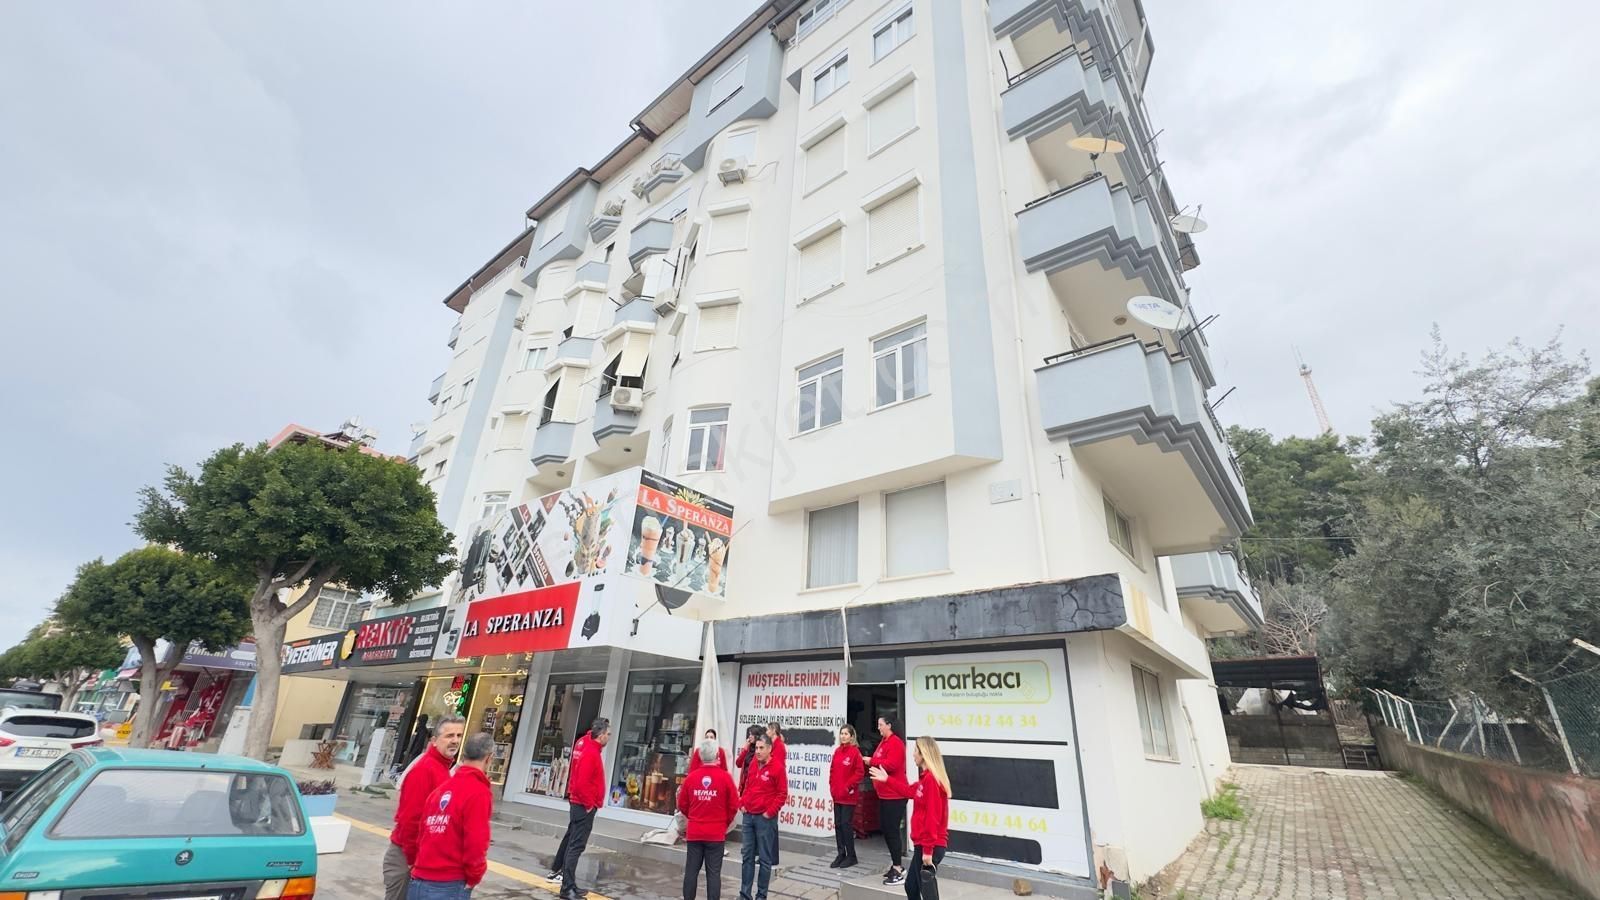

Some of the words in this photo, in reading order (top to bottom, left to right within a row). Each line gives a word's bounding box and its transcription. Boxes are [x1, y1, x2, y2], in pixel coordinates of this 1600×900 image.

[642, 489, 661, 509] LA
[667, 497, 729, 533] SPERANZA
[463, 620, 479, 637] LA
[485, 606, 563, 635] SPERANZA
[286, 640, 339, 665] VETERİNER
[747, 669, 840, 691] MÜŞTERİLERİMİZİN
[925, 666, 1021, 690] markacı
[764, 692, 818, 710] DİKKATİNE
[927, 713, 936, 726] 0
[939, 713, 962, 727] 546
[967, 714, 991, 728] 742
[996, 714, 1015, 728] 44
[1020, 714, 1039, 728] 34
[805, 752, 832, 764] ELEKTRO
[788, 765, 821, 777] ALETLERİ
[693, 789, 718, 797] RE/MAX
[788, 779, 801, 790] MİZ
[803, 779, 817, 792] İÇİN
[798, 796, 813, 810] 742
[815, 798, 826, 812] 44
[797, 813, 812, 828] 742
[814, 815, 825, 830] 44
[950, 809, 969, 824] 46
[971, 811, 998, 828] 742
[1004, 815, 1024, 829] 44
[1028, 816, 1049, 833] 64
